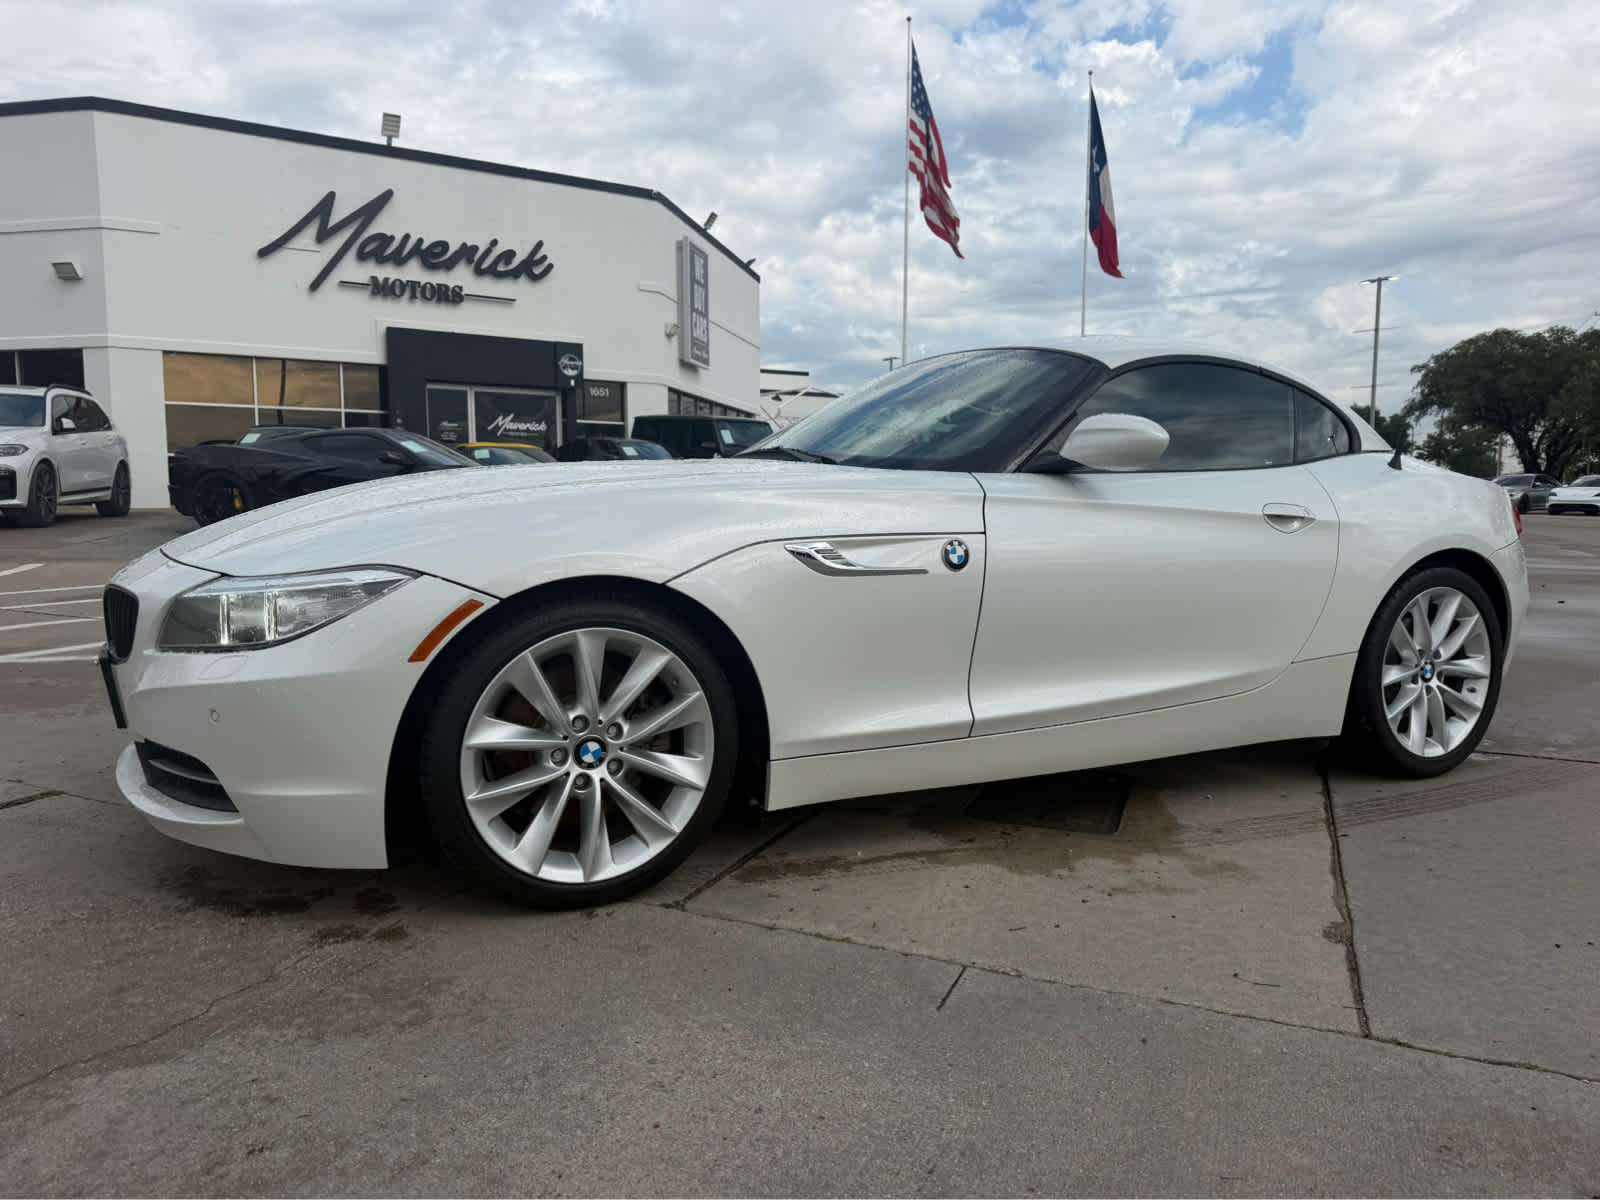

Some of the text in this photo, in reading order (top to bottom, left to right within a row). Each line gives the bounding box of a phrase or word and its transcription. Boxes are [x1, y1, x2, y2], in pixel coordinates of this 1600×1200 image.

[257, 188, 554, 292] Maverick
[370, 275, 465, 305] MOTORS
[487, 413, 547, 437] Maverick
